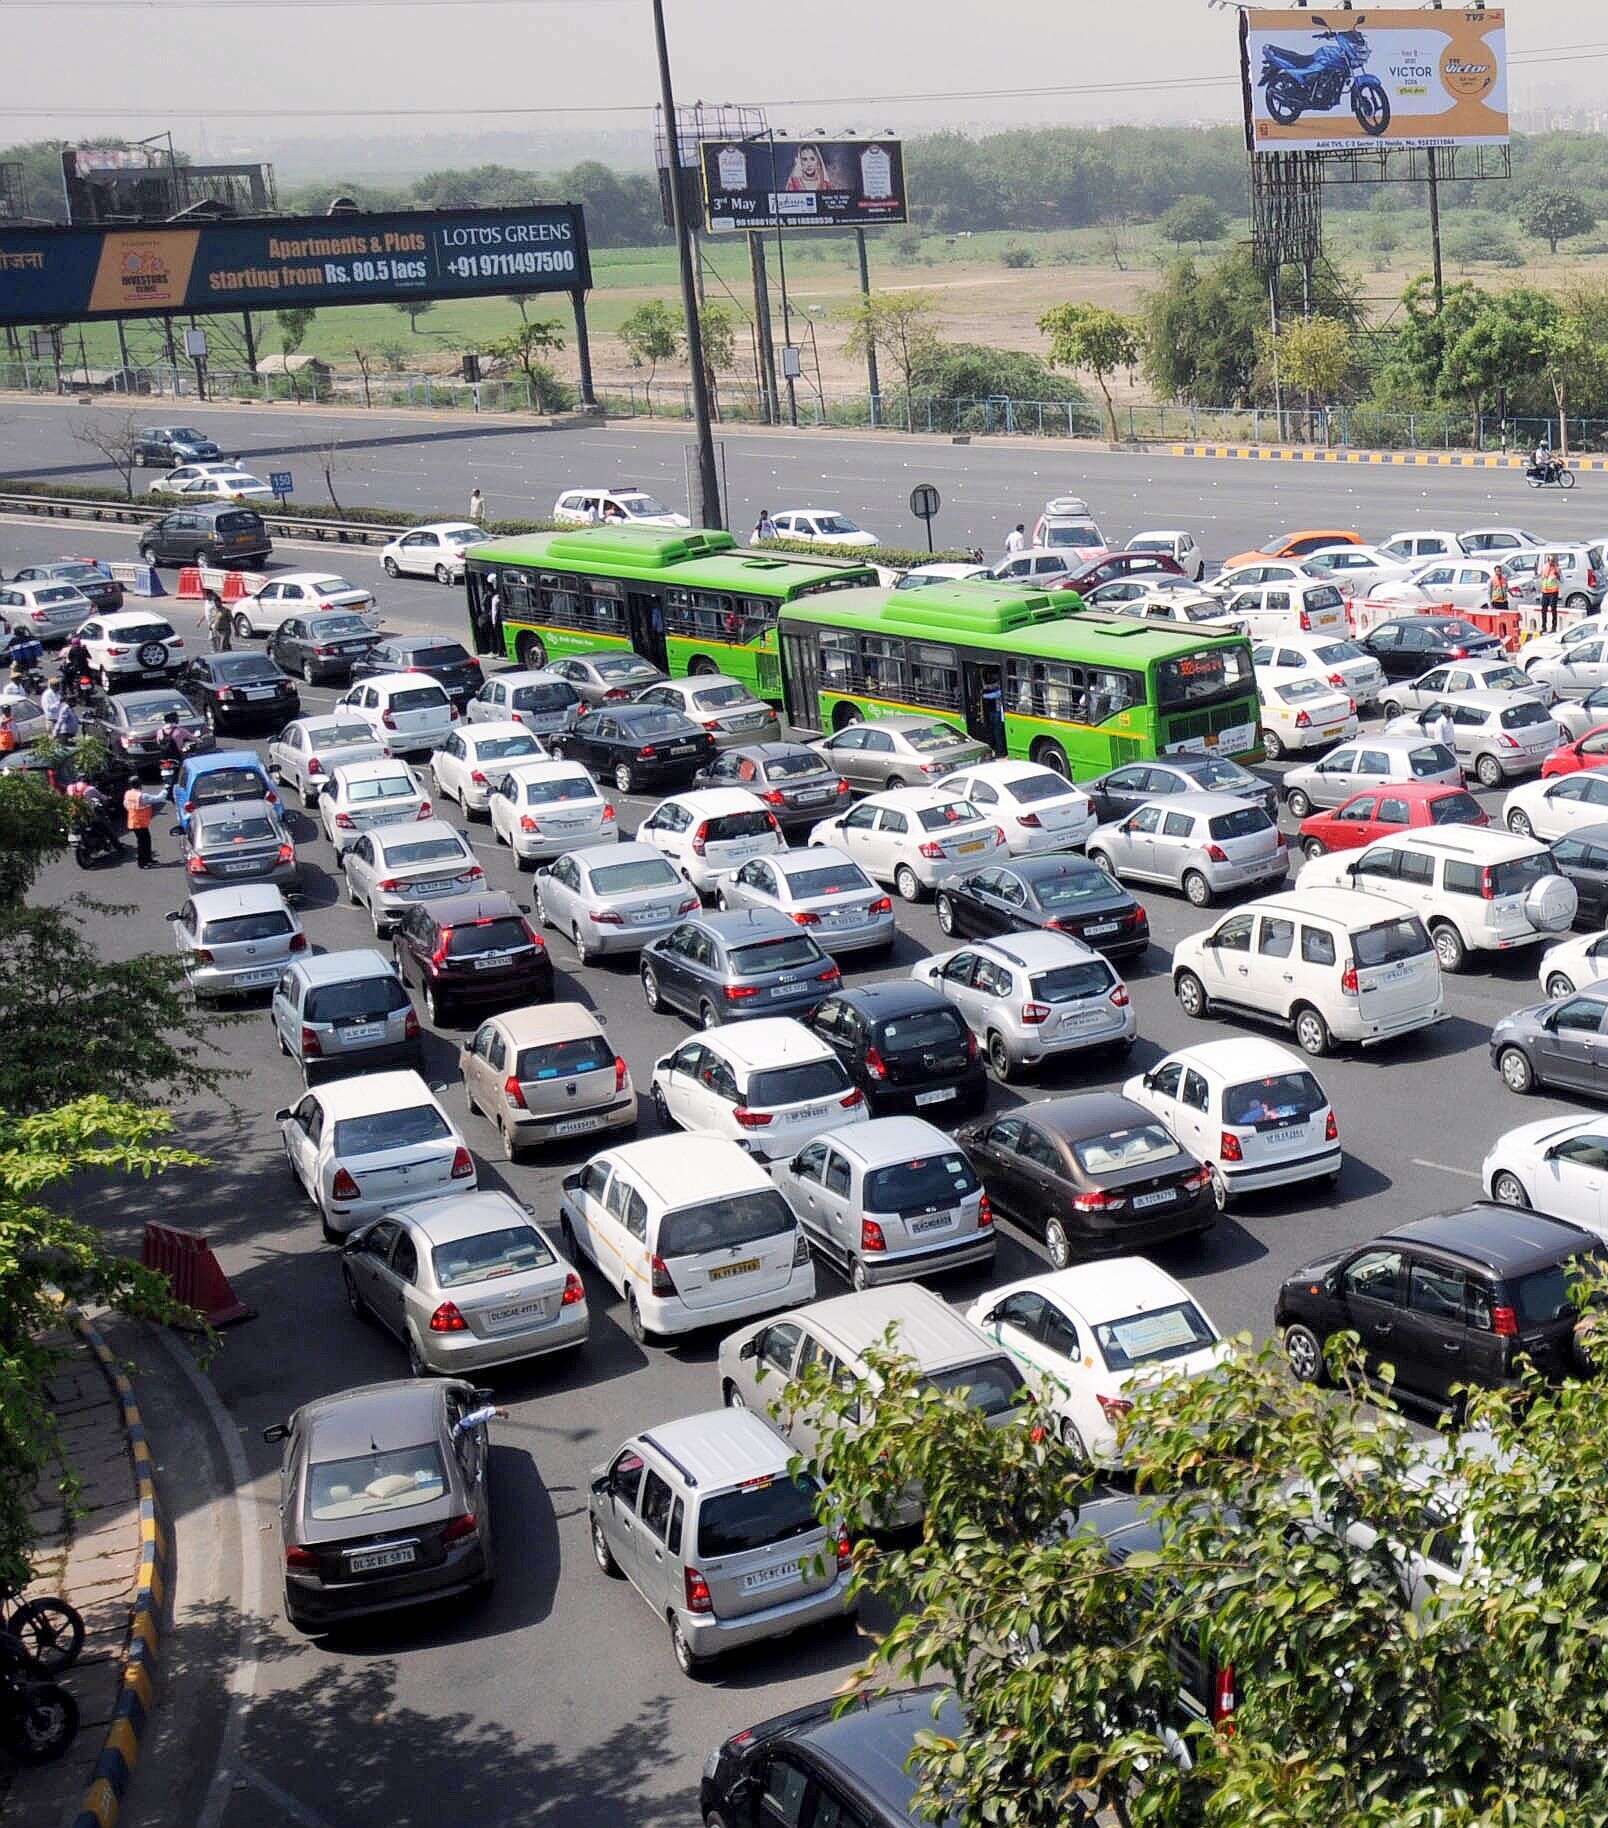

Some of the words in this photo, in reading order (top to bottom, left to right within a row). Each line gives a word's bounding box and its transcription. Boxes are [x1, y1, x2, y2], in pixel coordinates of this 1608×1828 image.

[1389, 66, 1432, 77] VICTOR
[731, 197, 756, 212] May
[269, 236, 367, 260] Apartments
[370, 236, 382, 252] &
[384, 232, 425, 251] Plots
[443, 227, 502, 246] LOTUS
[505, 223, 571, 243] GREENS
[209, 267, 279, 290] starting
[282, 266, 322, 286] from
[324, 263, 351, 284] Rs.
[353, 260, 389, 282] 80.5
[447, 255, 478, 277] +91
[480, 250, 574, 276] 9711497500
